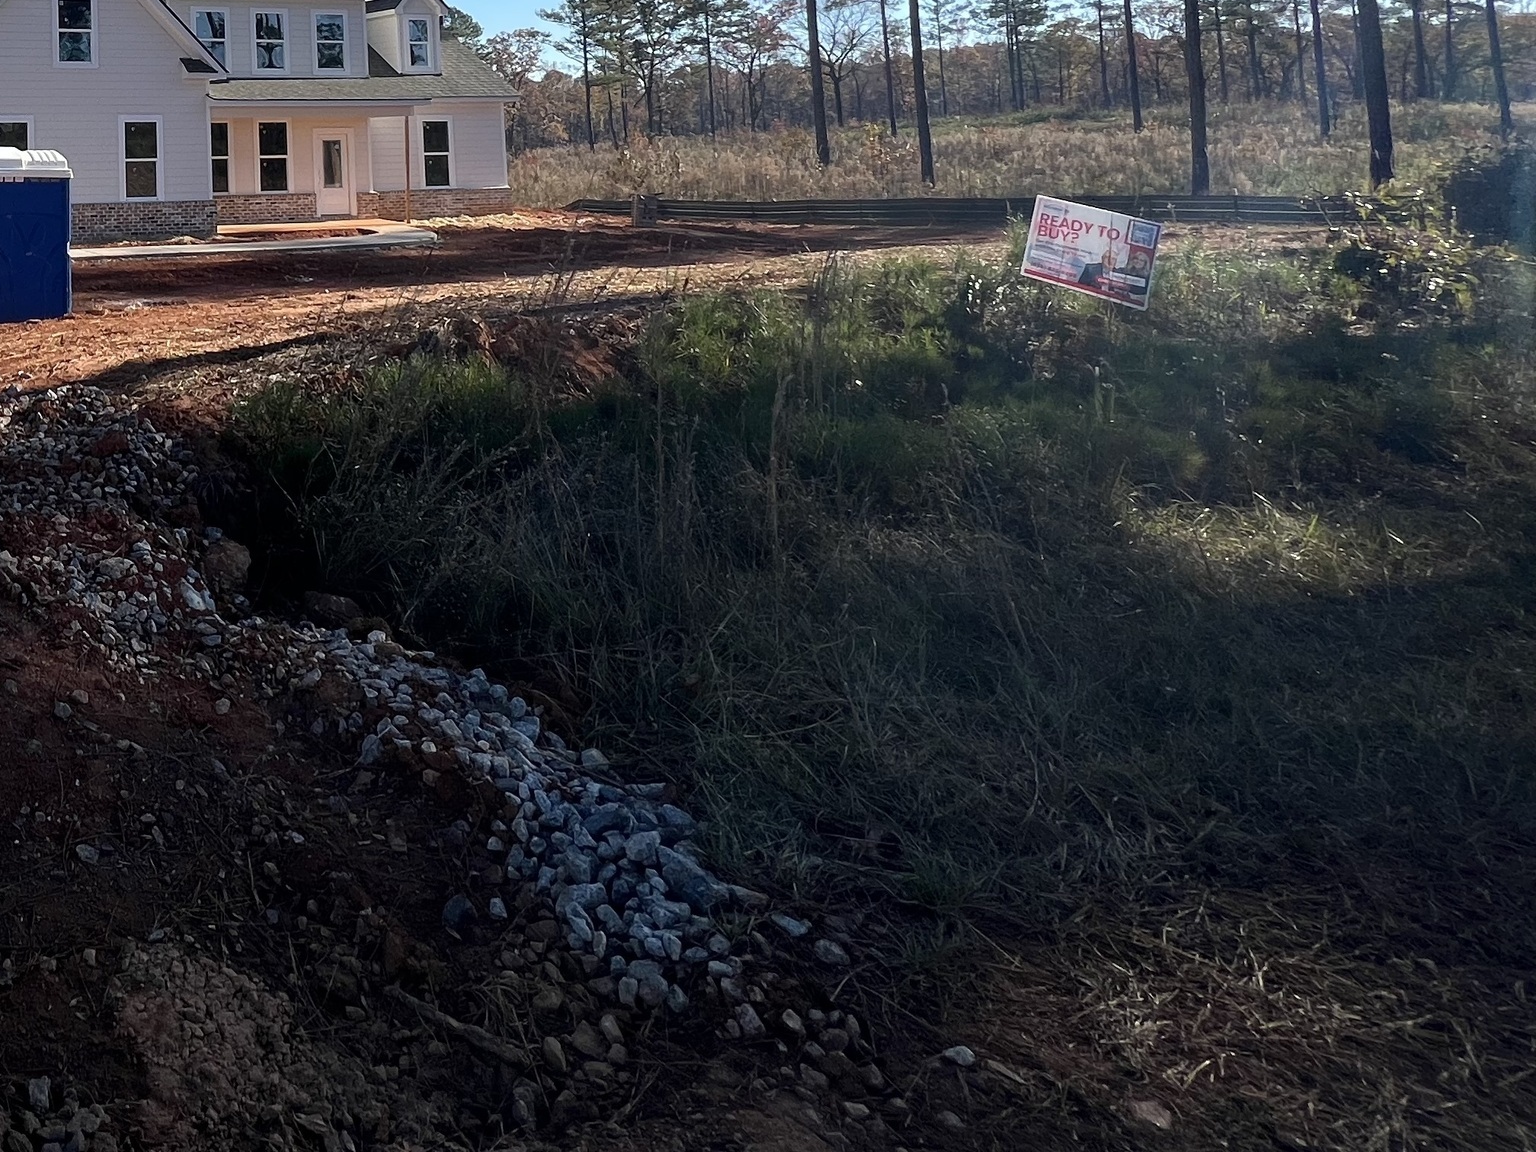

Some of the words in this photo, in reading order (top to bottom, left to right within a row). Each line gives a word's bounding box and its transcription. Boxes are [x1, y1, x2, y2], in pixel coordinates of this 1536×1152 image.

[1037, 225, 1079, 243] BUY?
[1040, 212, 1094, 234] READY
[1097, 225, 1120, 240] TO
